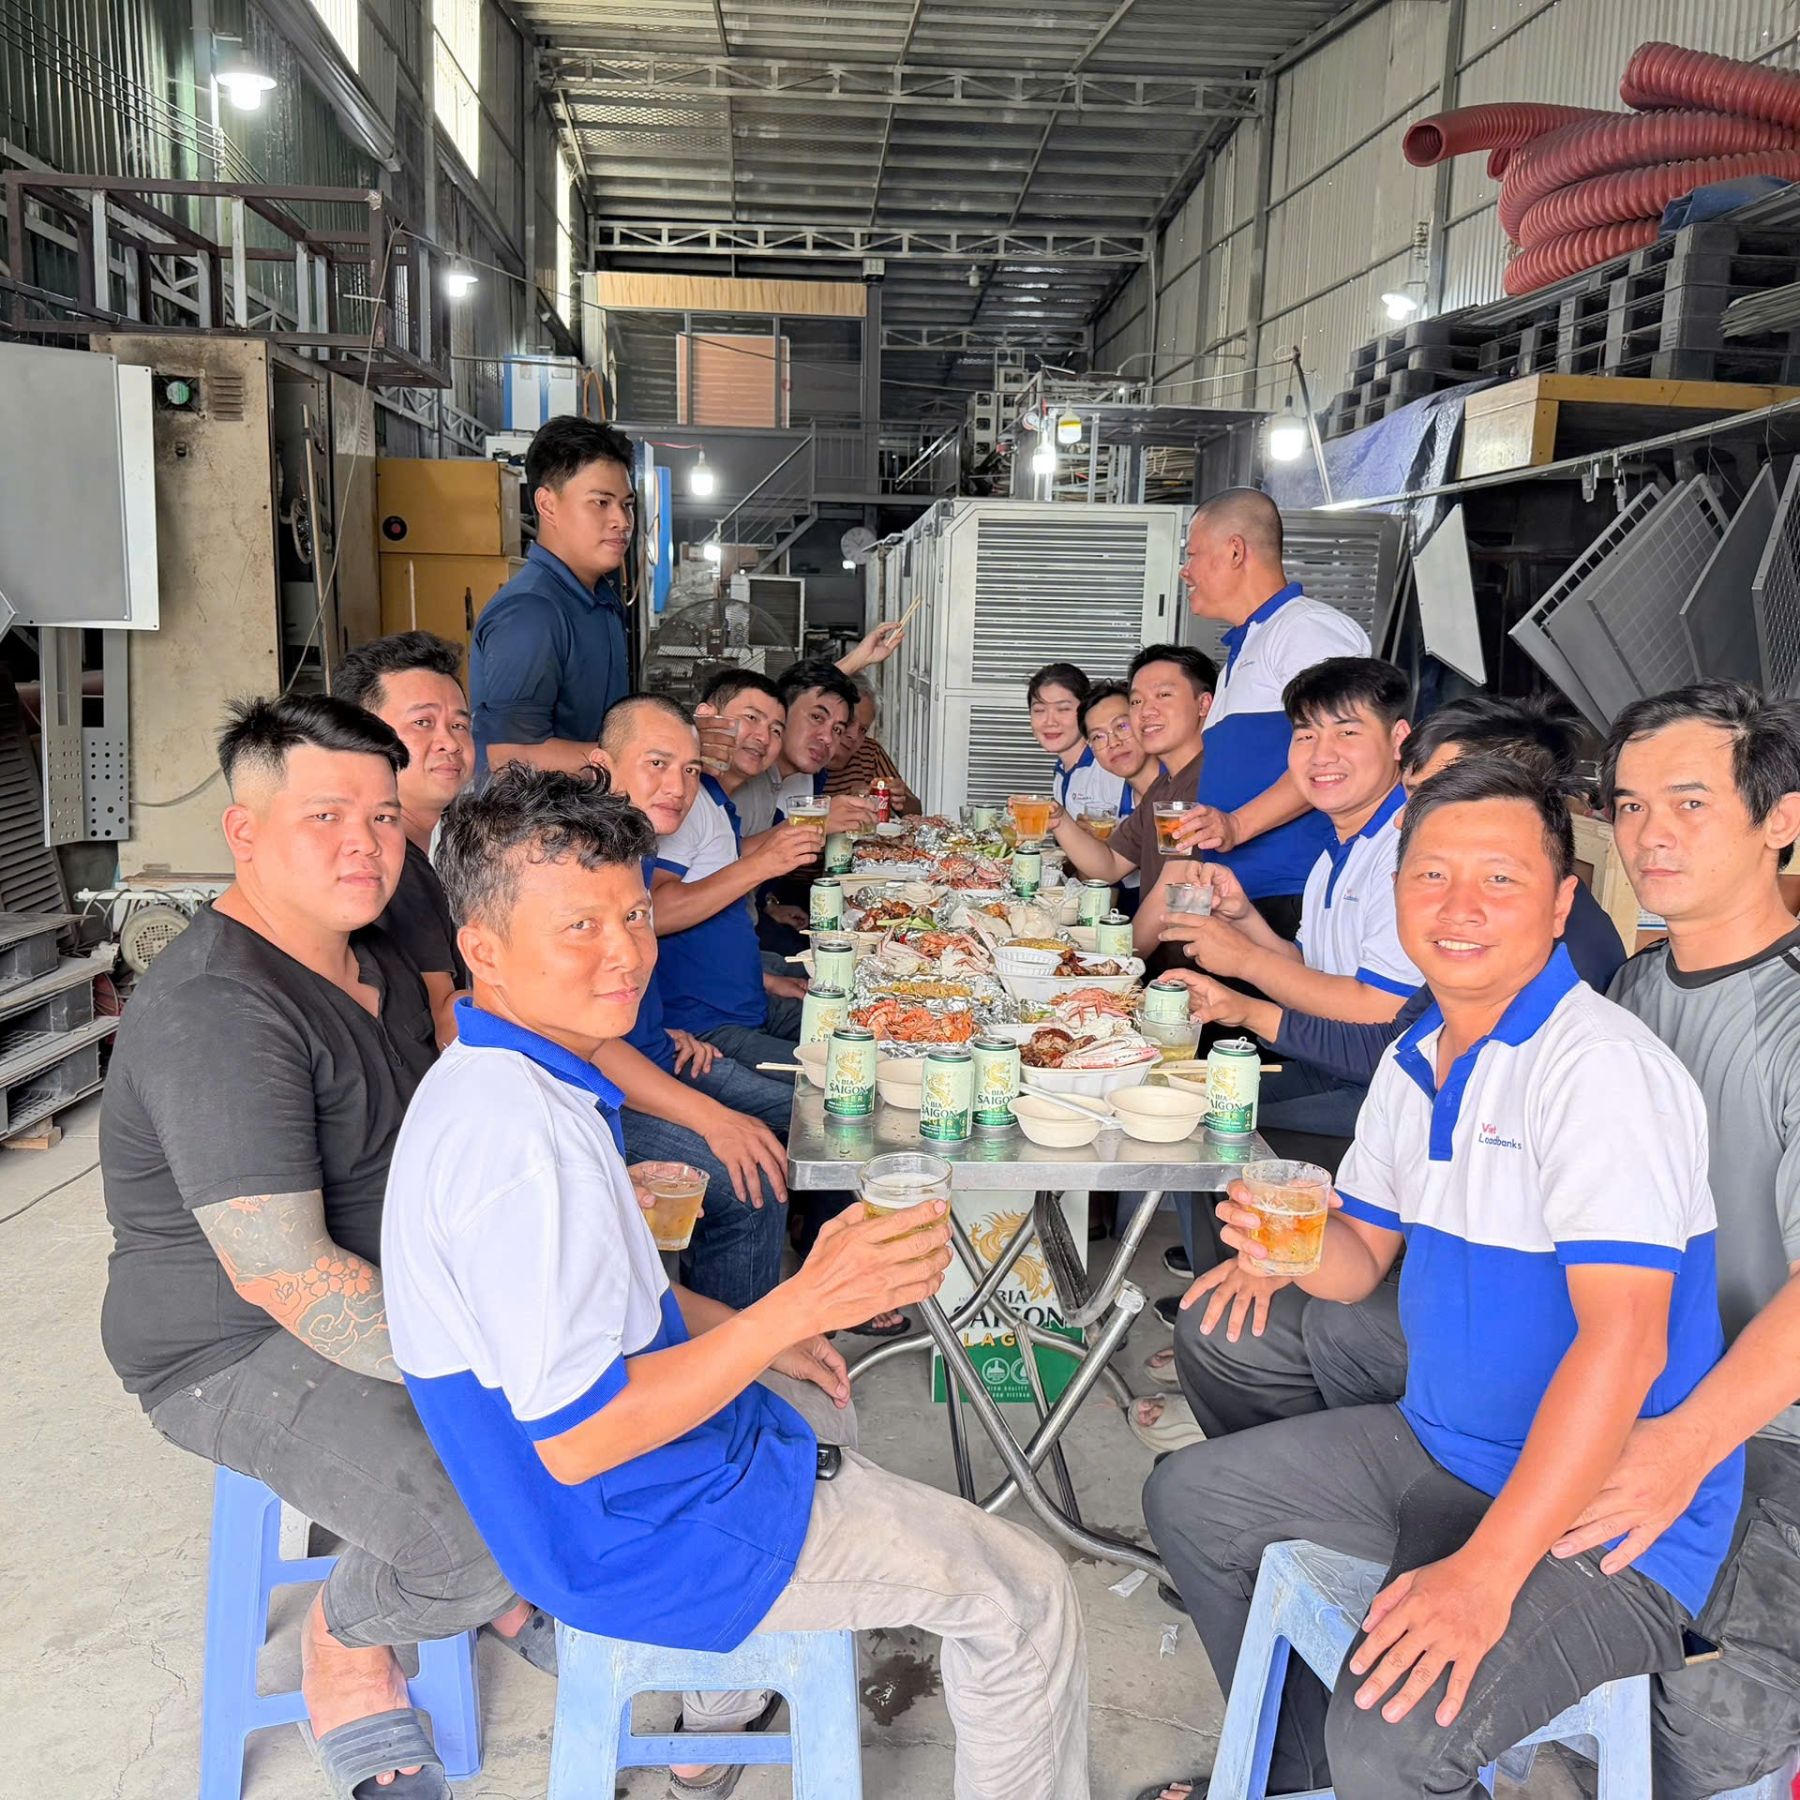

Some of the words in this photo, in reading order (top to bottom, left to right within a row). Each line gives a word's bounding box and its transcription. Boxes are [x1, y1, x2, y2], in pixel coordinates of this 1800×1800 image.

[829, 1081, 868, 1095] SAIGON
[1210, 1098, 1245, 1112] AIGON
[1479, 1133, 1522, 1150] Loadbanks
[963, 1332, 1017, 1347] LAG
